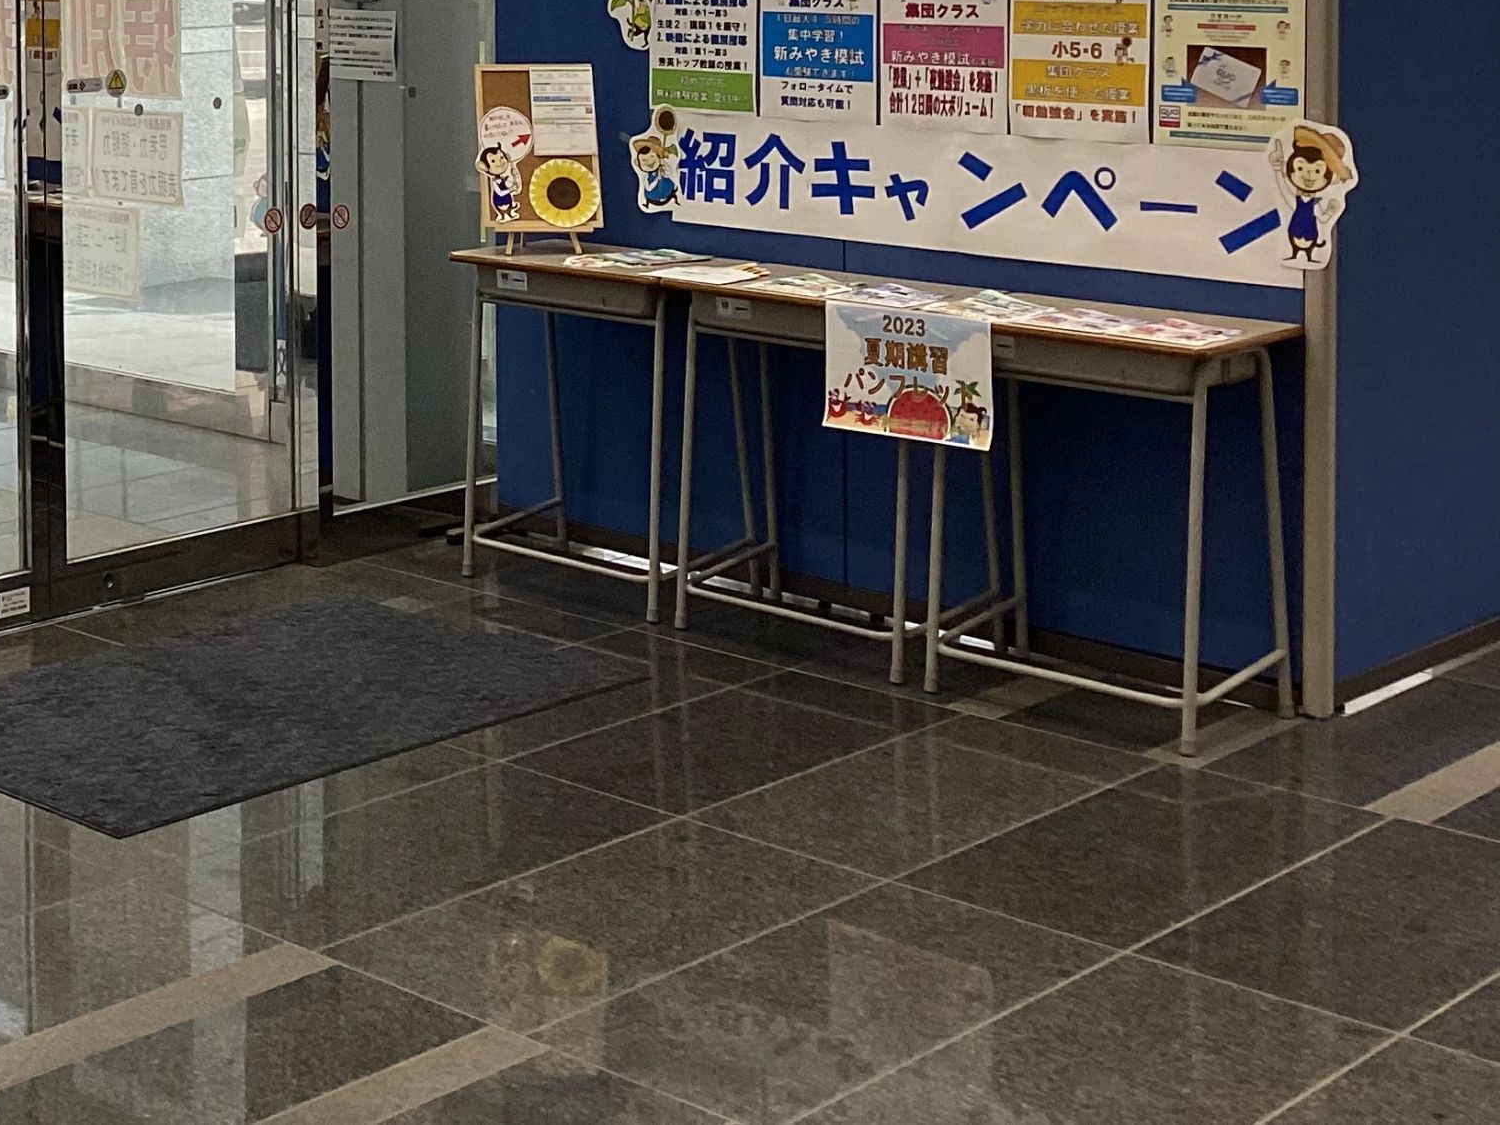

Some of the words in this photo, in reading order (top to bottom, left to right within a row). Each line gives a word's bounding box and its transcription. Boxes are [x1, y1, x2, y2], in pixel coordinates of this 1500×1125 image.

[905, 2, 980, 19] 集団クラス
[773, 45, 865, 65] 新みやき模試
[780, 80, 854, 95] フォロータイムで
[678, 127, 1282, 256] 紹介キャンペーン
[882, 314, 927, 338] 2023
[863, 337, 950, 375] 夏期講習
